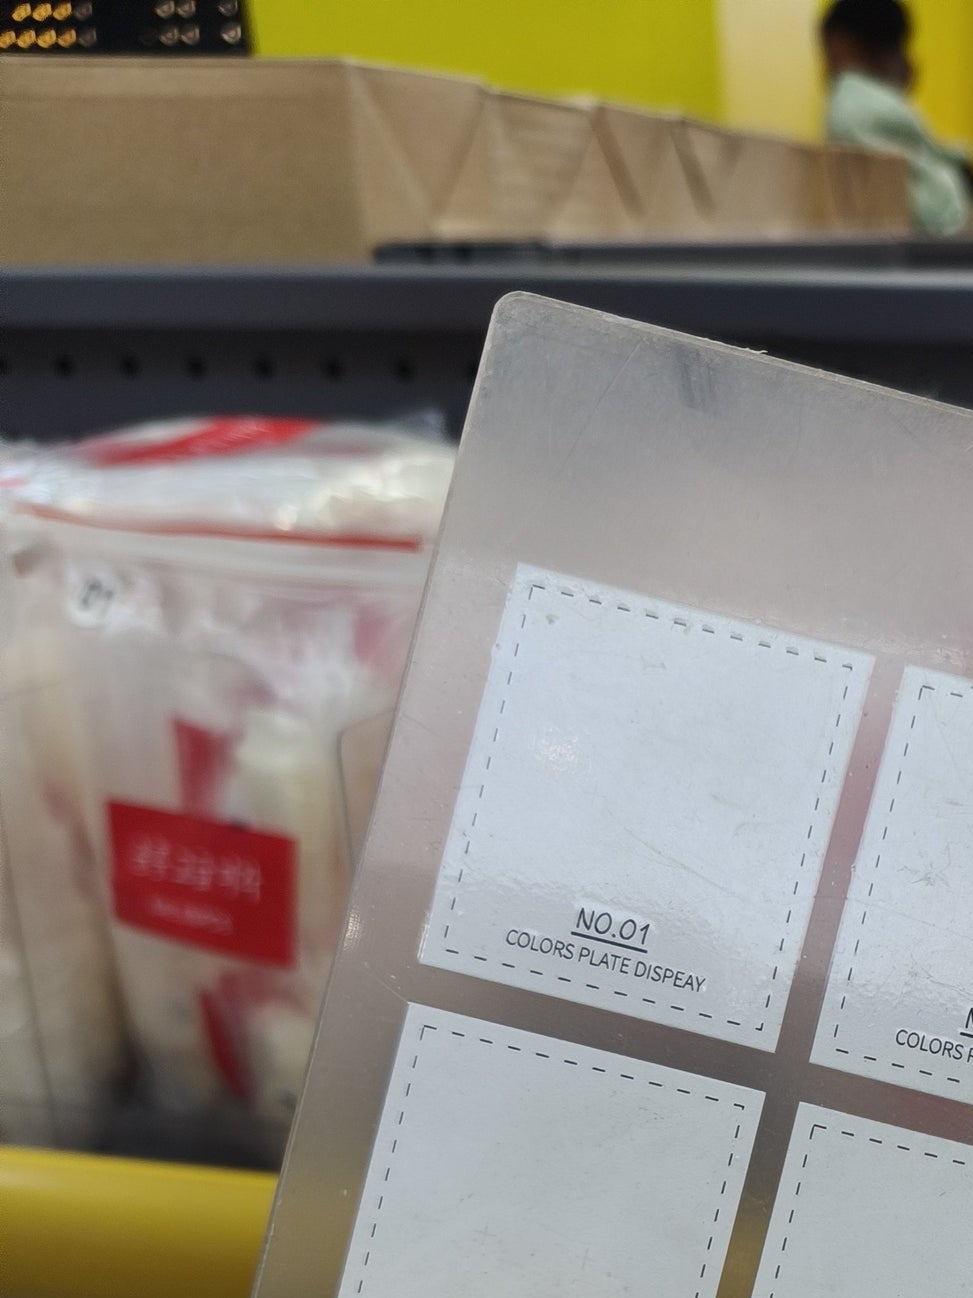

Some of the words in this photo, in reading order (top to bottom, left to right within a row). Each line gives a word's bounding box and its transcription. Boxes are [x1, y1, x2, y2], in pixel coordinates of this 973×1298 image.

[575, 907, 651, 945] NO.01
[506, 929, 575, 960] COLORS
[578, 947, 631, 974] PLATE
[634, 960, 706, 993] DISPEAY
[895, 1029, 964, 1060] COLORS
